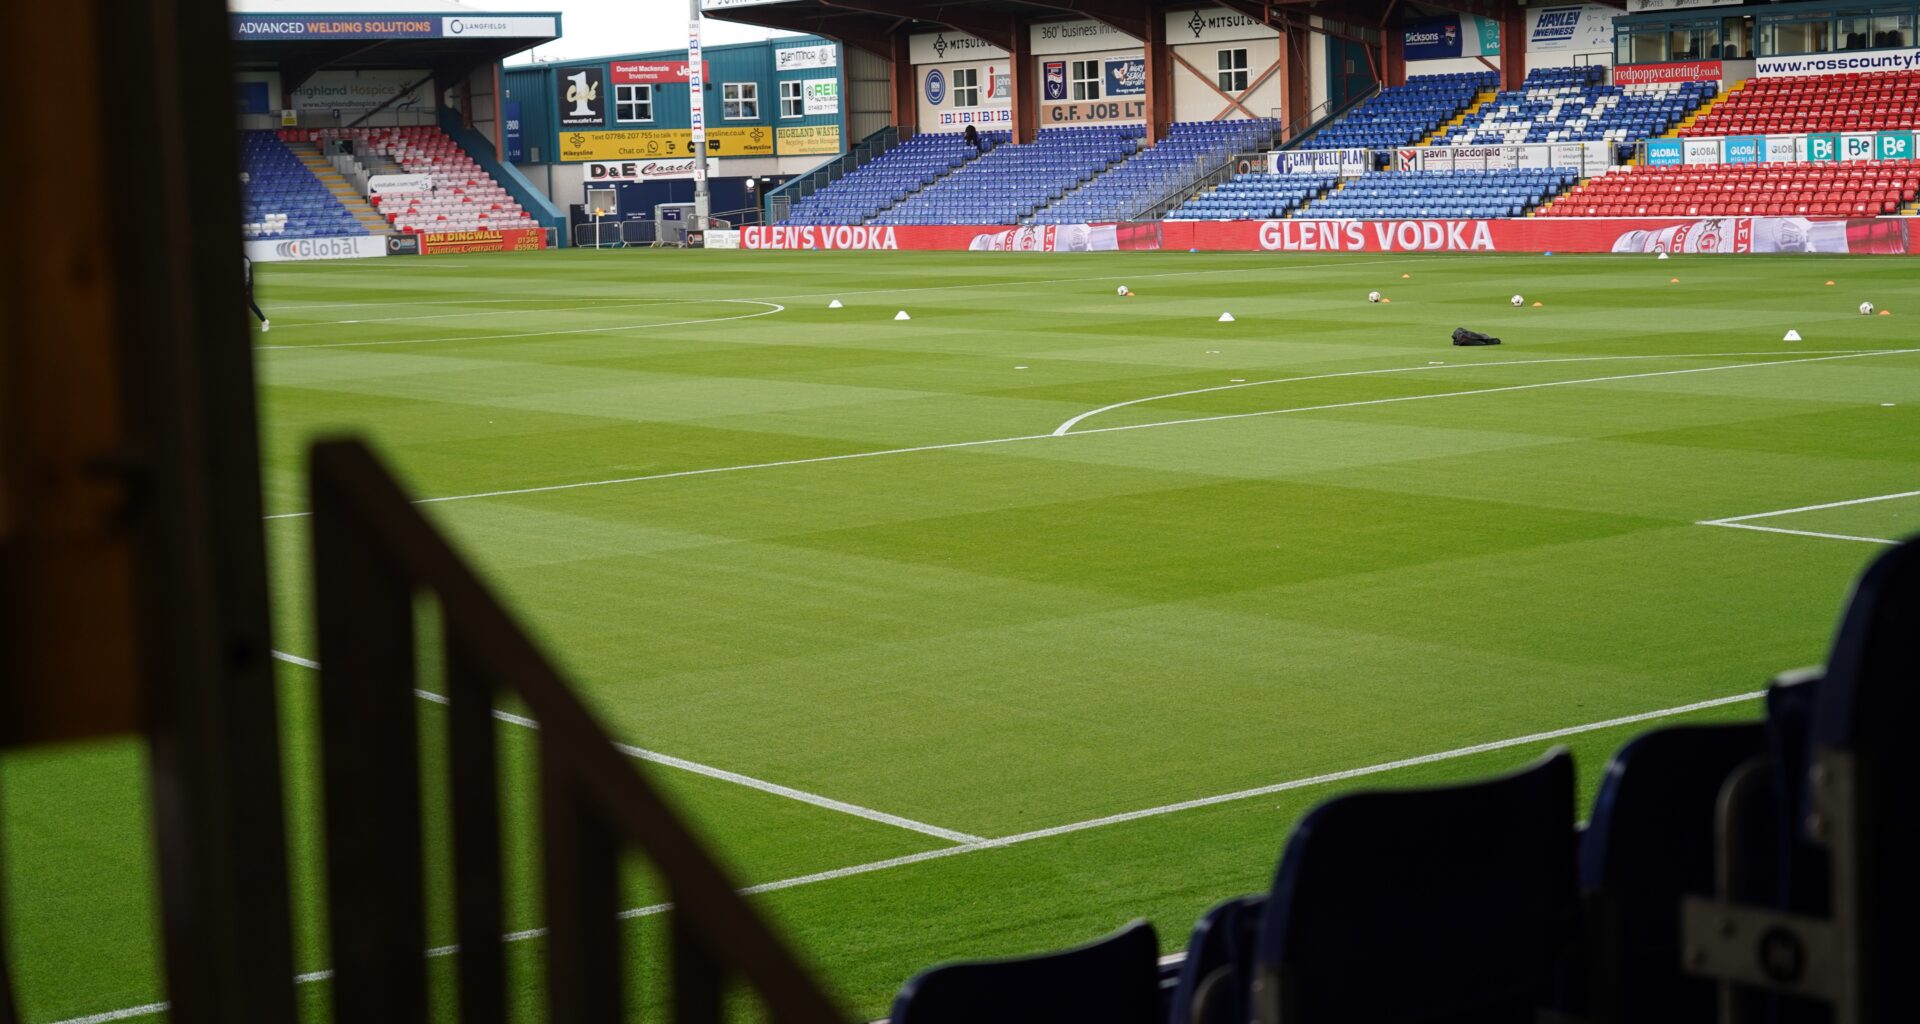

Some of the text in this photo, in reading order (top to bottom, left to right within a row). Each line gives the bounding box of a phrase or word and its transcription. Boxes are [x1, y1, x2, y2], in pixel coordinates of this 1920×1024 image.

[1537, 11, 1581, 28] HAYLEY
[239, 21, 431, 34] ADVANCED WELDING SOLUTIONS
[1061, 25, 1097, 38] business
[1533, 27, 1575, 37] INVERNESS
[1405, 32, 1439, 42] Dicksons
[677, 65, 690, 76] Je
[1616, 64, 1720, 83] redpoppycatering.co.uk
[996, 77, 1010, 86] john
[350, 84, 396, 96] Hospice
[941, 113, 956, 124] IBI
[959, 112, 975, 123] IBI
[978, 111, 994, 121] IBI
[1052, 102, 1144, 121] G.F. JOB LT
[641, 131, 652, 139] 755
[778, 126, 839, 138] HIGHLAND WASTE
[1650, 148, 1680, 157] GLOBAL
[1690, 147, 1717, 156] GLOBA
[1813, 139, 1832, 158] Be
[1848, 138, 1870, 156] Be
[1883, 136, 1906, 156] Be
[1342, 150, 1364, 164] PLAN
[448, 231, 503, 240] DINGWALL
[820, 226, 898, 250] VODKA
[1259, 220, 1496, 250] GLEN'S VODKA
[299, 238, 360, 256] Global
